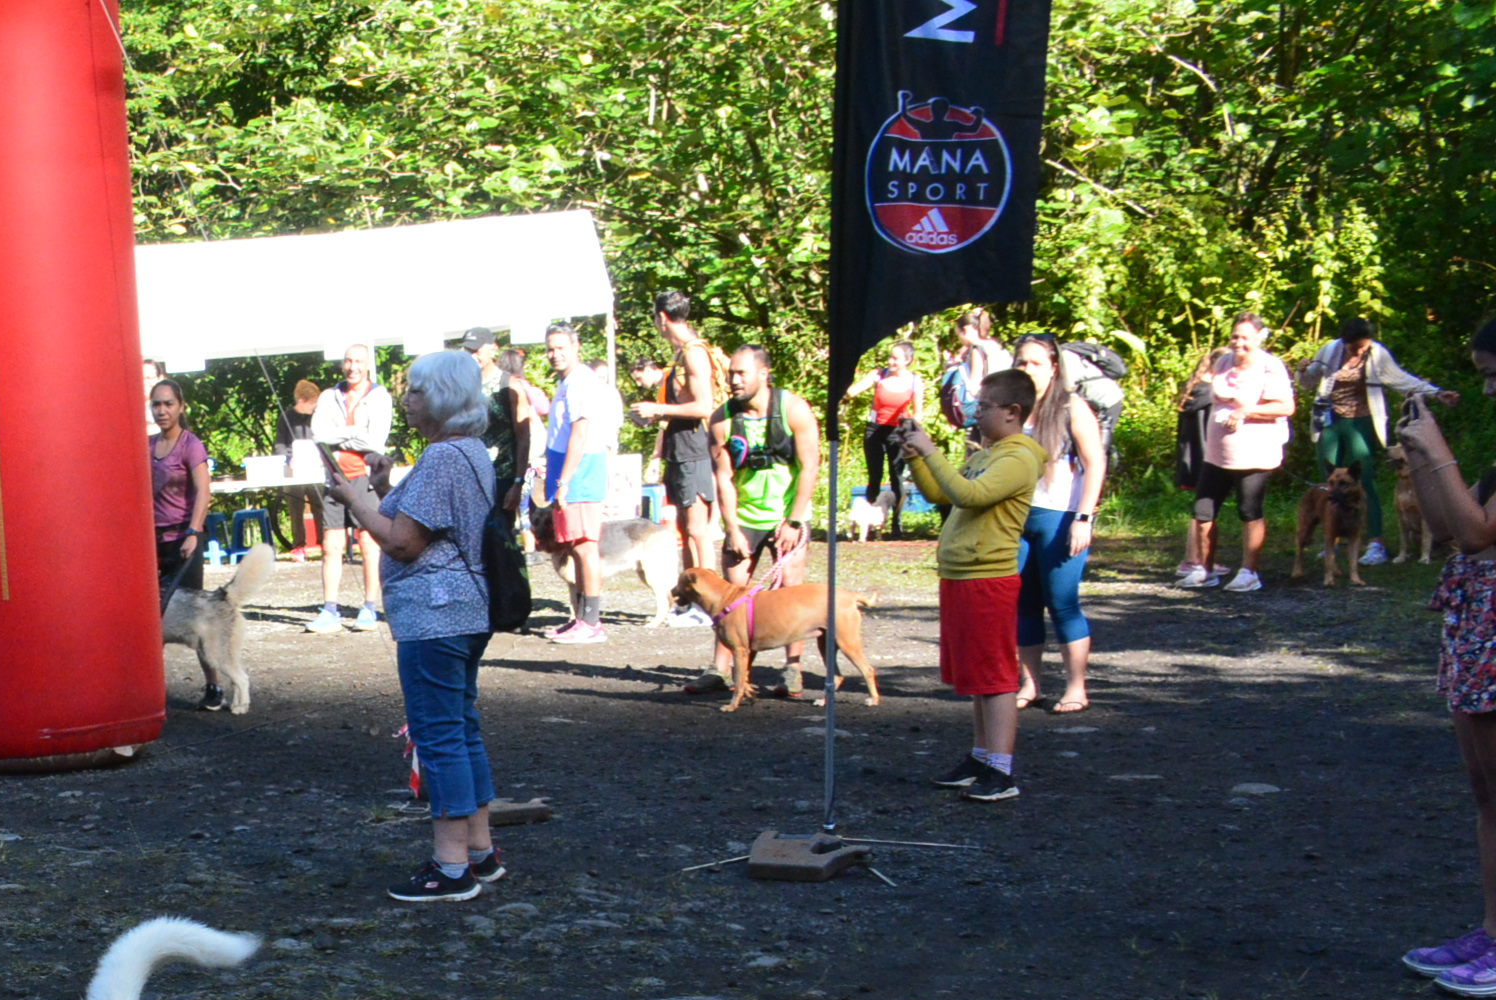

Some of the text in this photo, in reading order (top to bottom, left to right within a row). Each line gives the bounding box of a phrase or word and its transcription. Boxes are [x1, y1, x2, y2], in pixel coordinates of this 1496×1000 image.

[888, 147, 990, 175] MANA
[888, 181, 989, 201] SPORT
[906, 230, 958, 246] adidas
